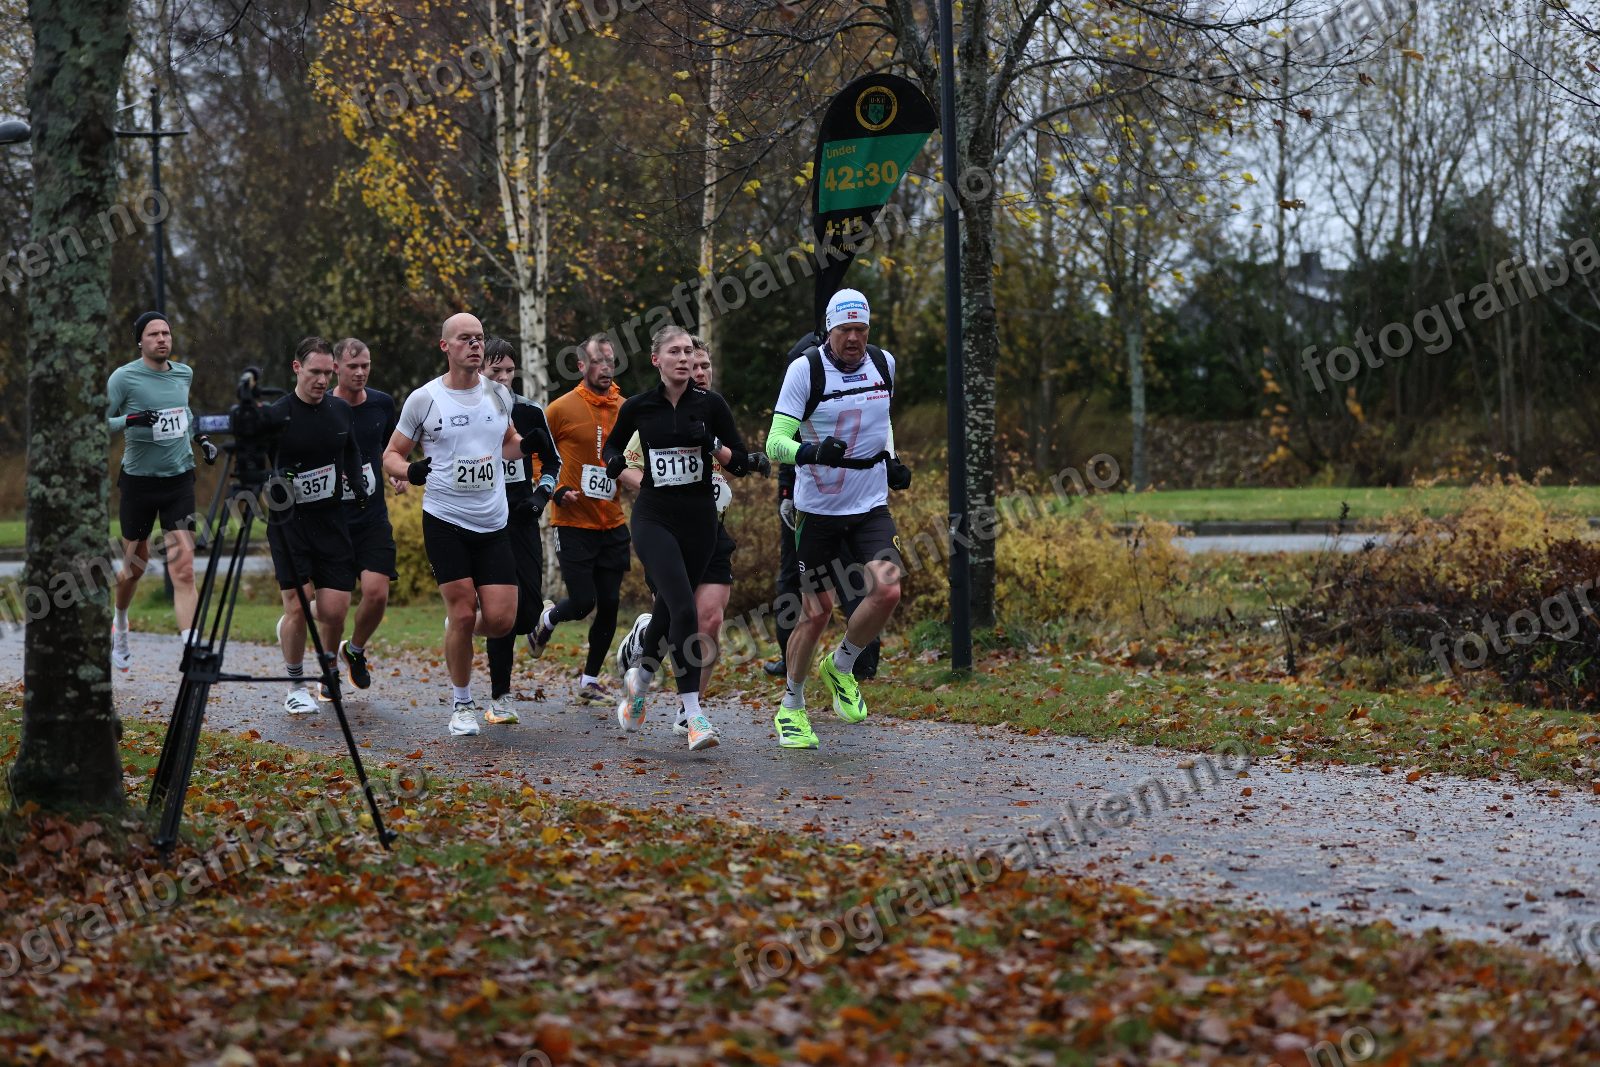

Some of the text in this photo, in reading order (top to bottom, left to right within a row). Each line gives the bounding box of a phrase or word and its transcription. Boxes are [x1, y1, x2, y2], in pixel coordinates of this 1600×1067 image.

[826, 144, 857, 159] Under
[825, 160, 899, 192] 42:30
[826, 216, 862, 236] 4:15
[161, 416, 181, 432] 211
[457, 463, 494, 483] 2140
[655, 455, 698, 477] 9118
[302, 475, 329, 495] 357
[589, 475, 612, 493] 640
